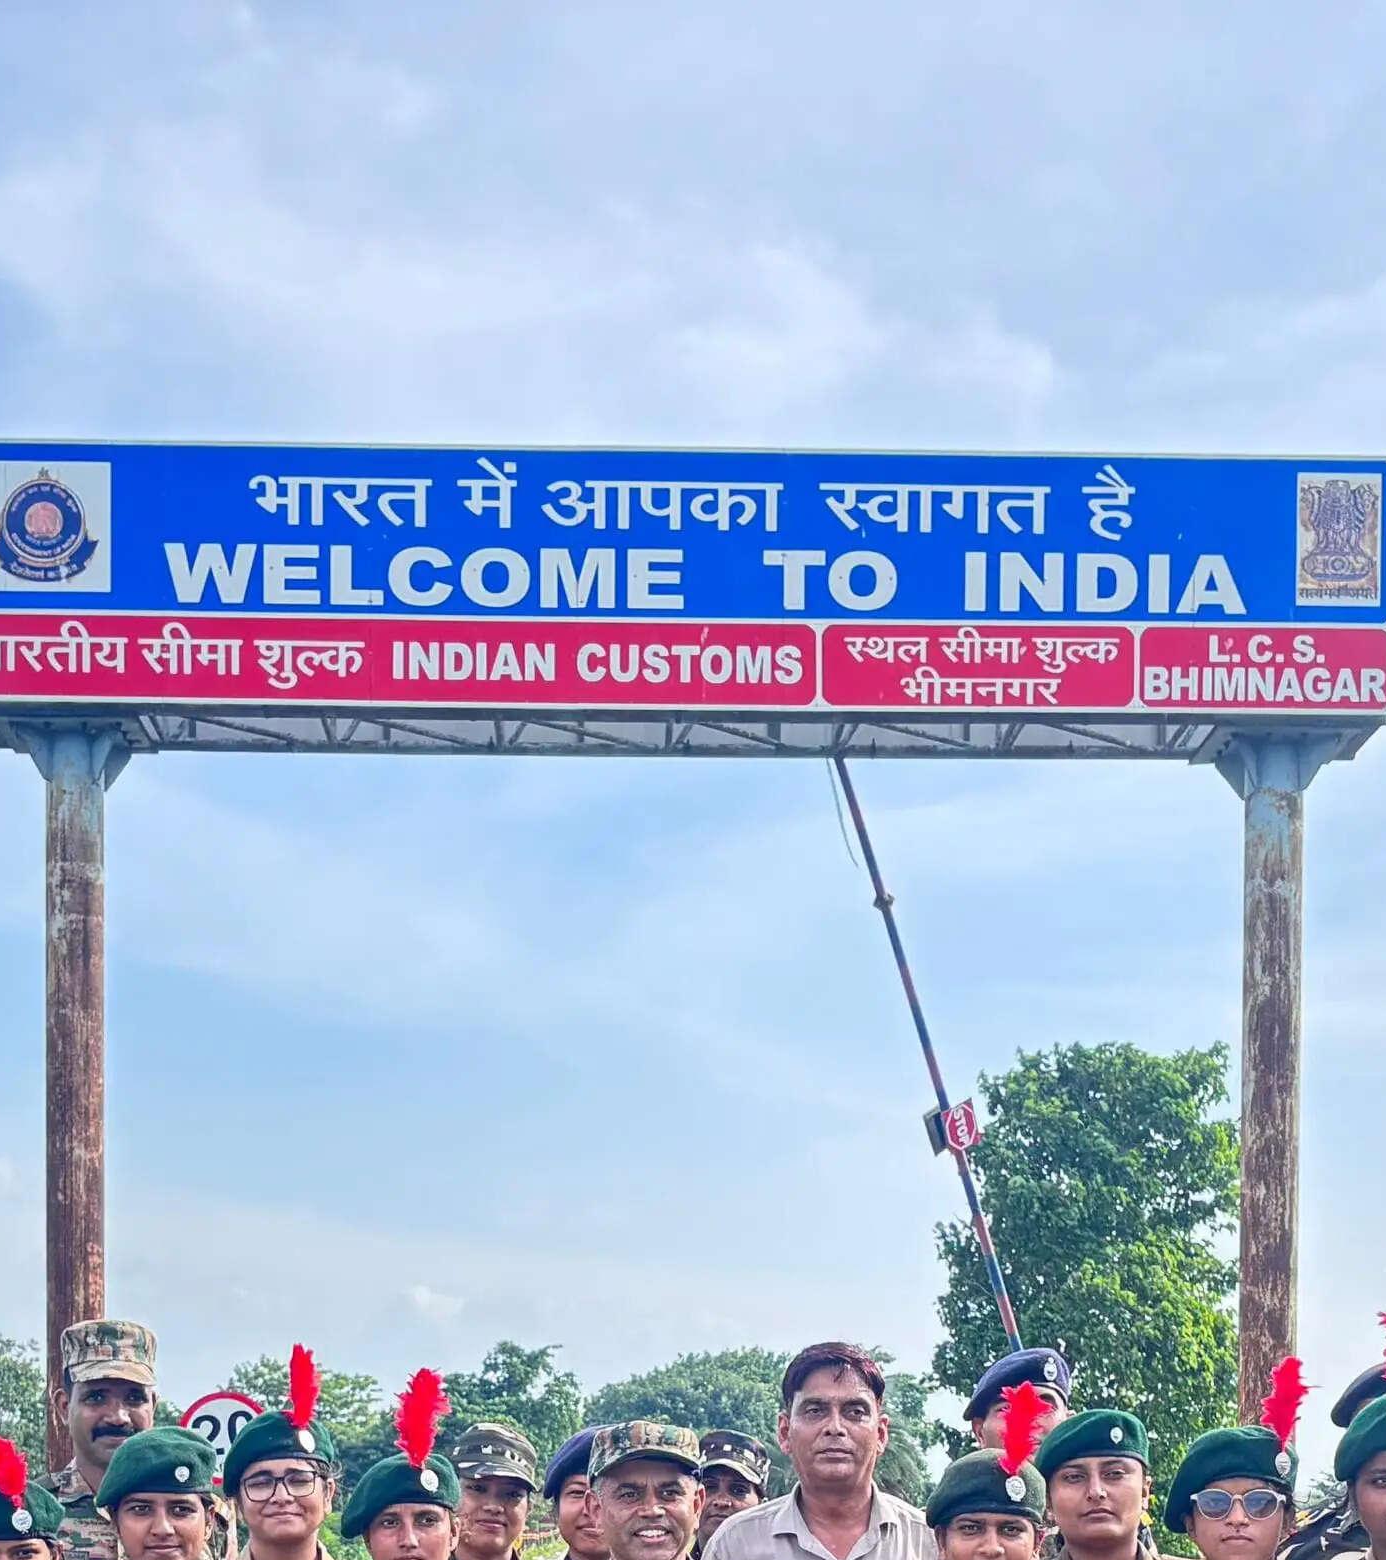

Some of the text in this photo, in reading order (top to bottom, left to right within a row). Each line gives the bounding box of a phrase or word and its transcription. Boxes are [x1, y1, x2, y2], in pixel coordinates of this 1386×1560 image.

[249, 457, 1136, 541] भारत में आपका स्वागत है
[163, 542, 1247, 615] WELCOME TO INDIA
[138, 621, 243, 676] सीमा
[253, 639, 365, 689] शुल्क
[392, 640, 803, 684] INDIAN CUSTOMS
[843, 626, 1121, 674] स्थल सीमा शुल्क
[899, 666, 1062, 705] भीमनगर
[1143, 666, 1386, 703] BHIMNAGAR
